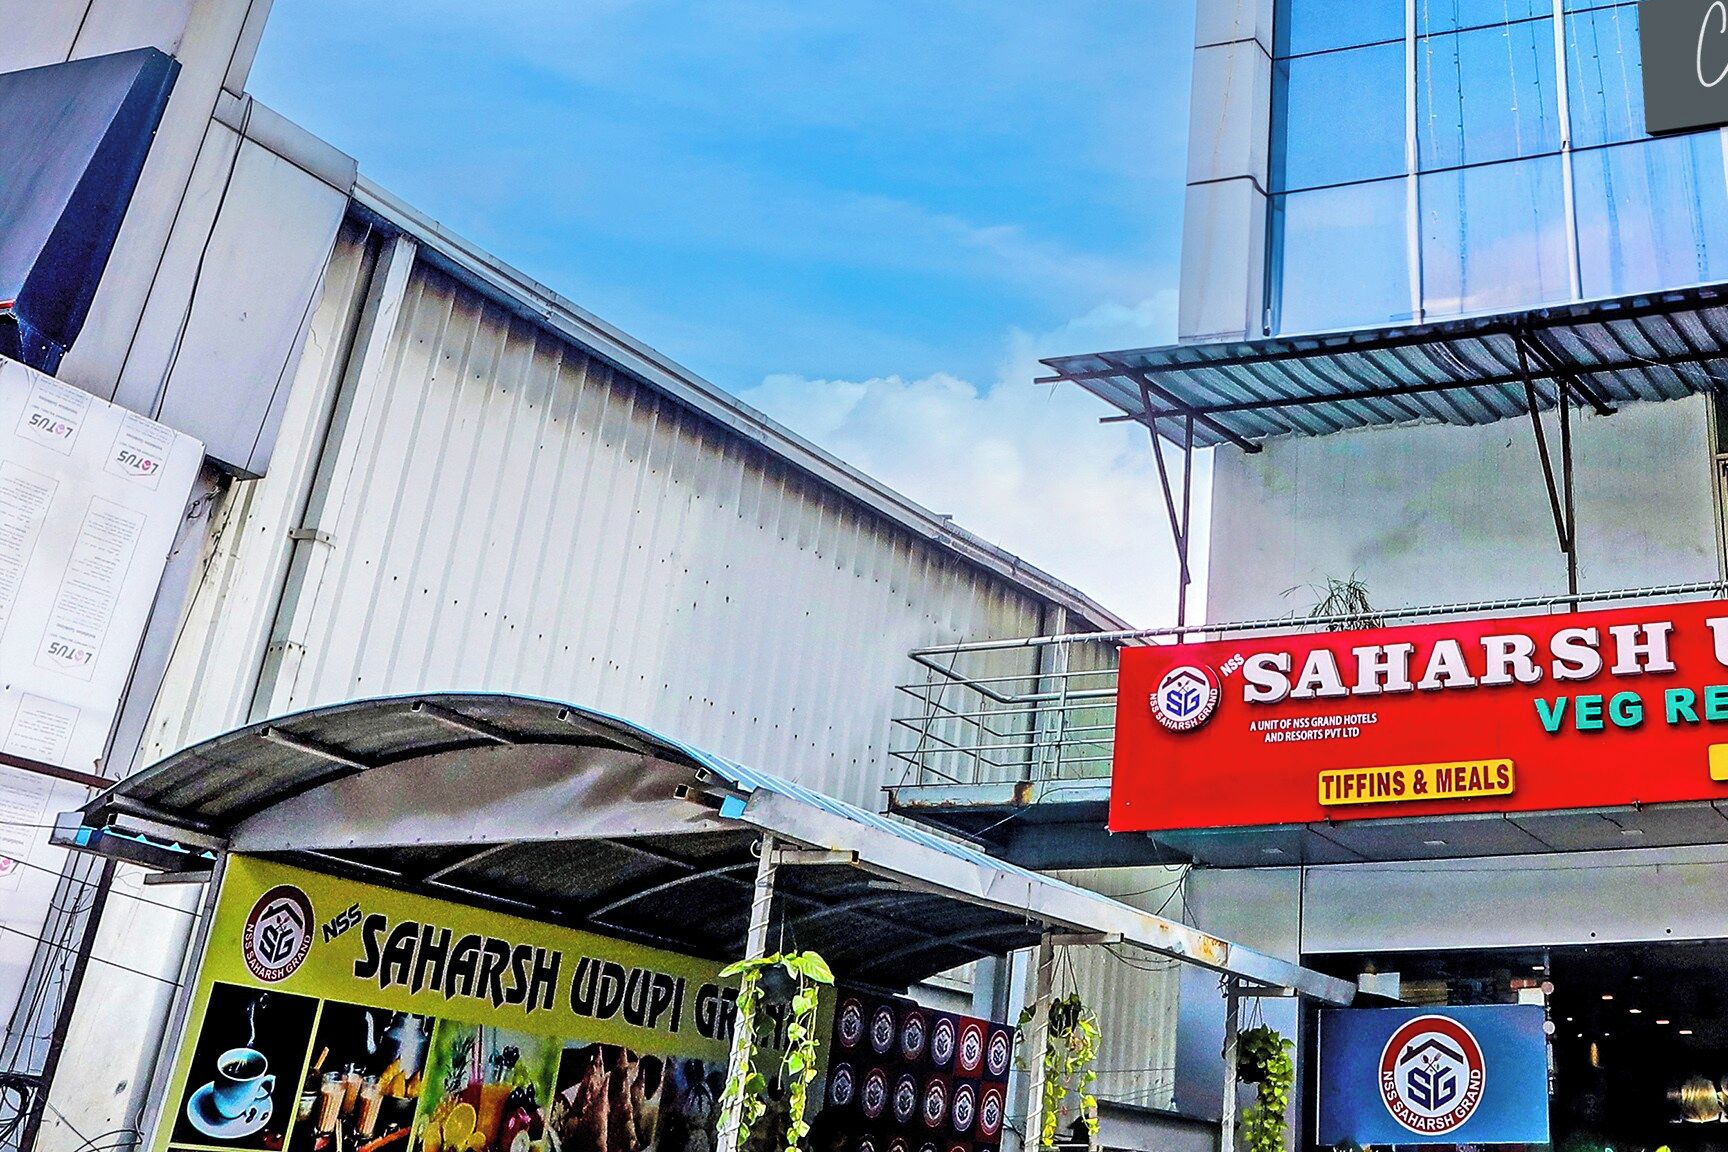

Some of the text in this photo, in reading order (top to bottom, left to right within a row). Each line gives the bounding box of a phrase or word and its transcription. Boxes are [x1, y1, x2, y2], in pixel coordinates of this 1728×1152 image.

[1220, 653, 1245, 677] NSS
[1243, 620, 1676, 704] SAHARSH
[1149, 688, 1219, 730] NSS SAHARSH GRAND
[1250, 713, 1378, 731] A UNIT OF NSS GRAND HOTELS
[1534, 689, 1645, 734] VEG
[1264, 727, 1360, 743] AND RESORTS PVT LTD
[1322, 764, 1510, 800] TIFFINS & MEALS
[322, 902, 363, 944] NSS
[244, 923, 312, 980] NSS SAHARSH GRAND
[353, 913, 564, 1015] SAHARSH
[569, 956, 686, 1034] UDUPI
[1383, 1069, 1481, 1131] NSS SAHARSH GRAND
